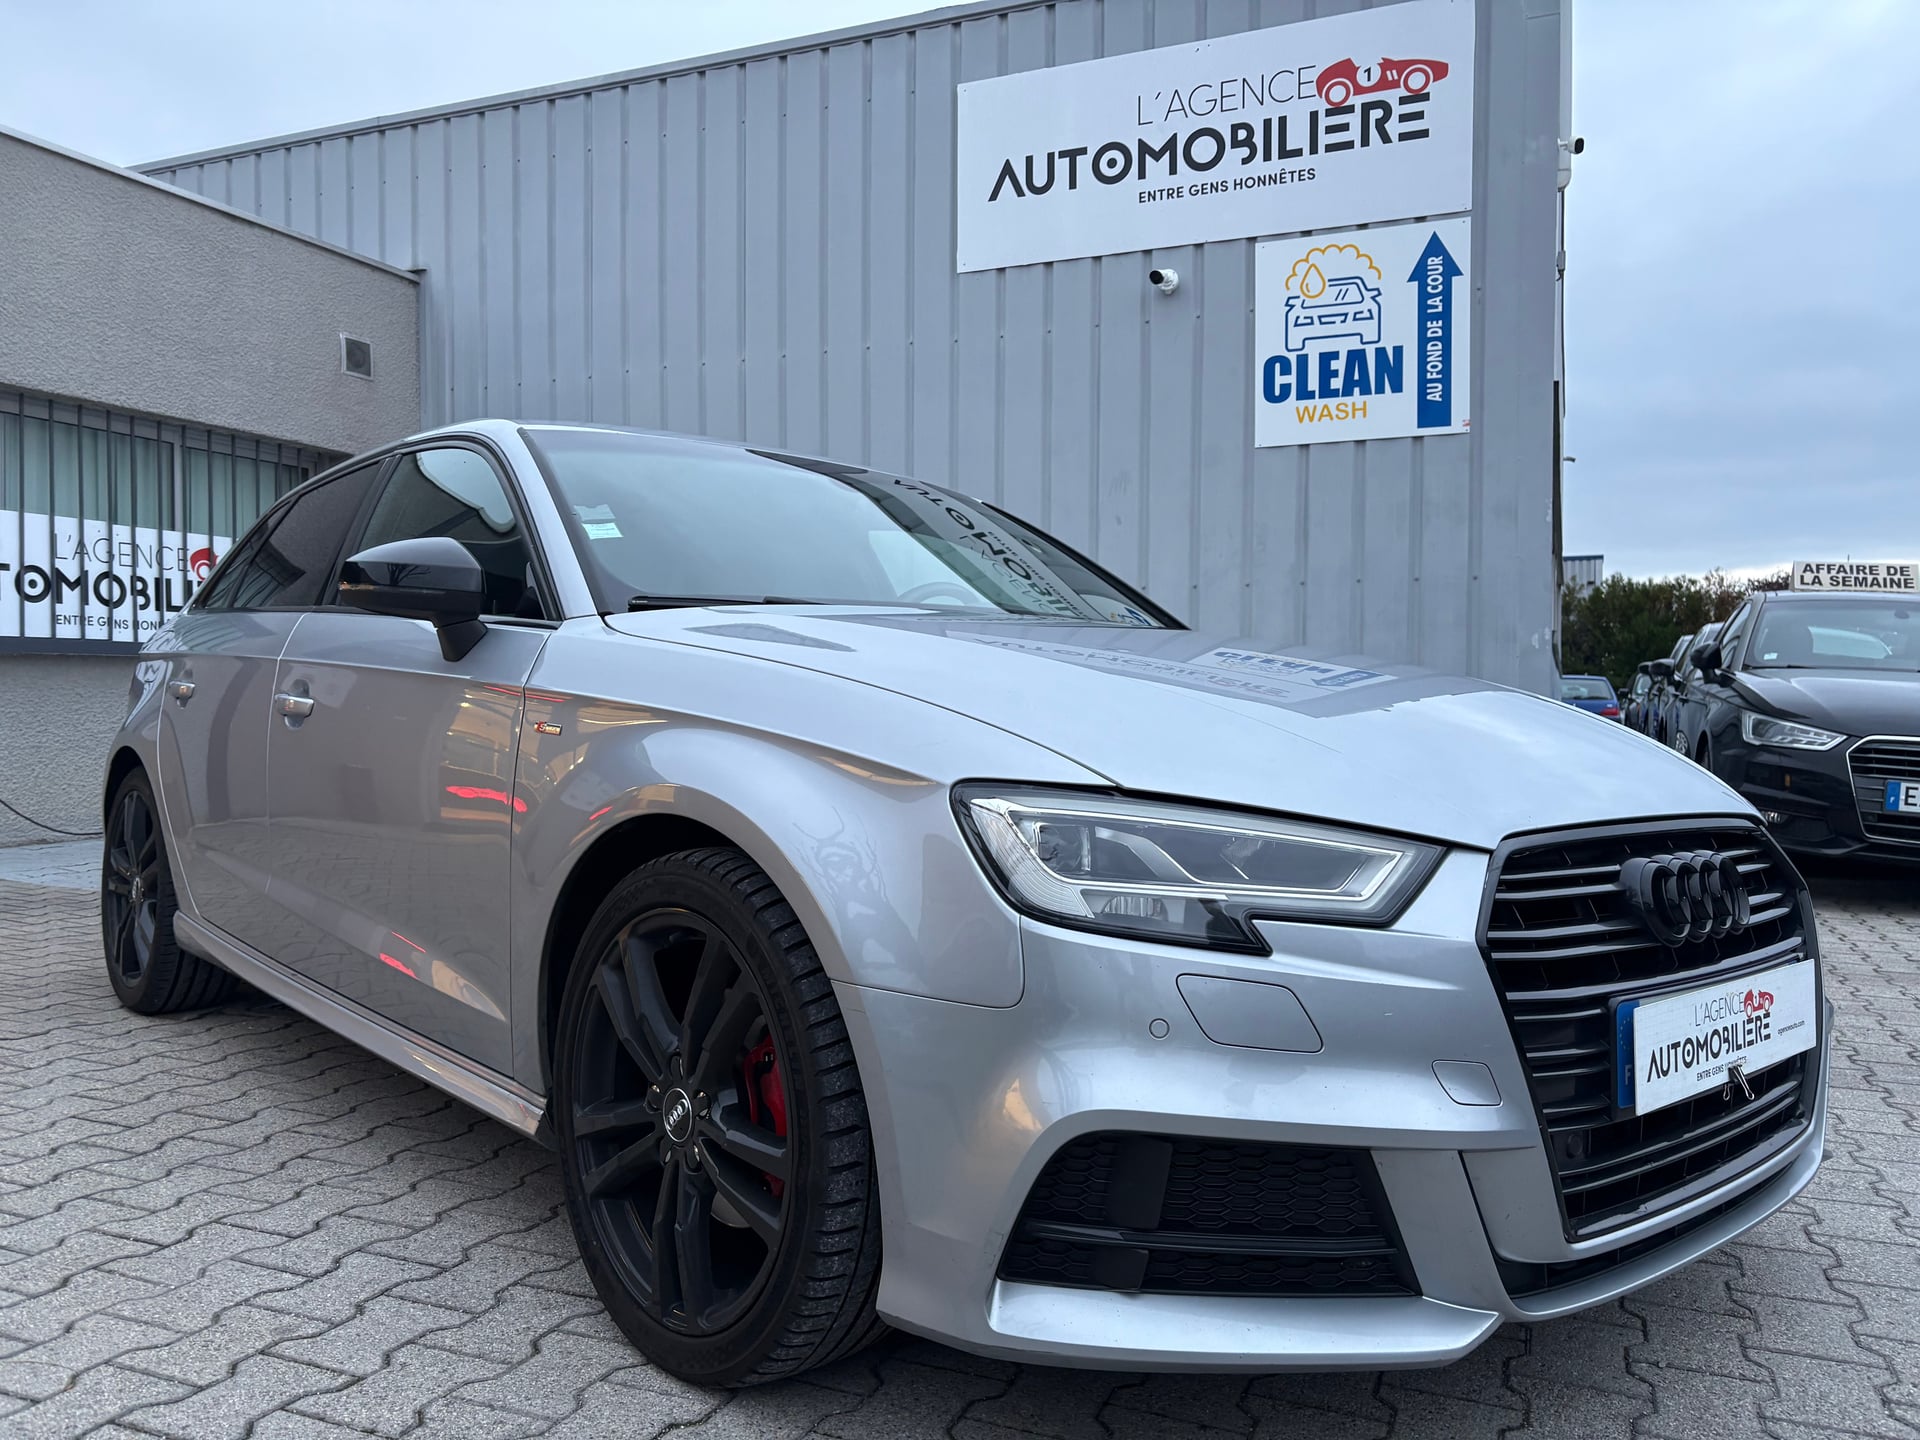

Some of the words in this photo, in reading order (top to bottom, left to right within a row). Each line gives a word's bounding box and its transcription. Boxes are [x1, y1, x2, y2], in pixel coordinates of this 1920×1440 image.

[1363, 66, 1371, 82] 1
[1138, 65, 1317, 126] L'AGENCE
[987, 92, 1430, 202] AUTOMOBILIERE
[1138, 186, 1184, 203] ENTRE
[1188, 180, 1229, 197] GENS
[1233, 167, 1316, 191] HONNÊTES
[1427, 255, 1443, 294] COUR
[1426, 296, 1443, 313] LA
[1426, 319, 1443, 338] DE
[1426, 340, 1443, 379] FOND
[1262, 345, 1403, 405] CLEAN
[1426, 382, 1443, 402] AU
[1295, 401, 1367, 424] WASH
[1802, 563, 1880, 576] AFFAIRE
[1886, 566, 1911, 577] DE
[1800, 575, 1823, 586] LA
[1829, 575, 1915, 589] SEMAINE
[1904, 786, 1920, 806] E
[1694, 991, 1744, 1027] L'AGENCE
[1646, 1012, 1772, 1083] AUTOMOBILIERE
[1624, 1065, 1631, 1085] F
[1696, 1067, 1712, 1082] ENTRE
